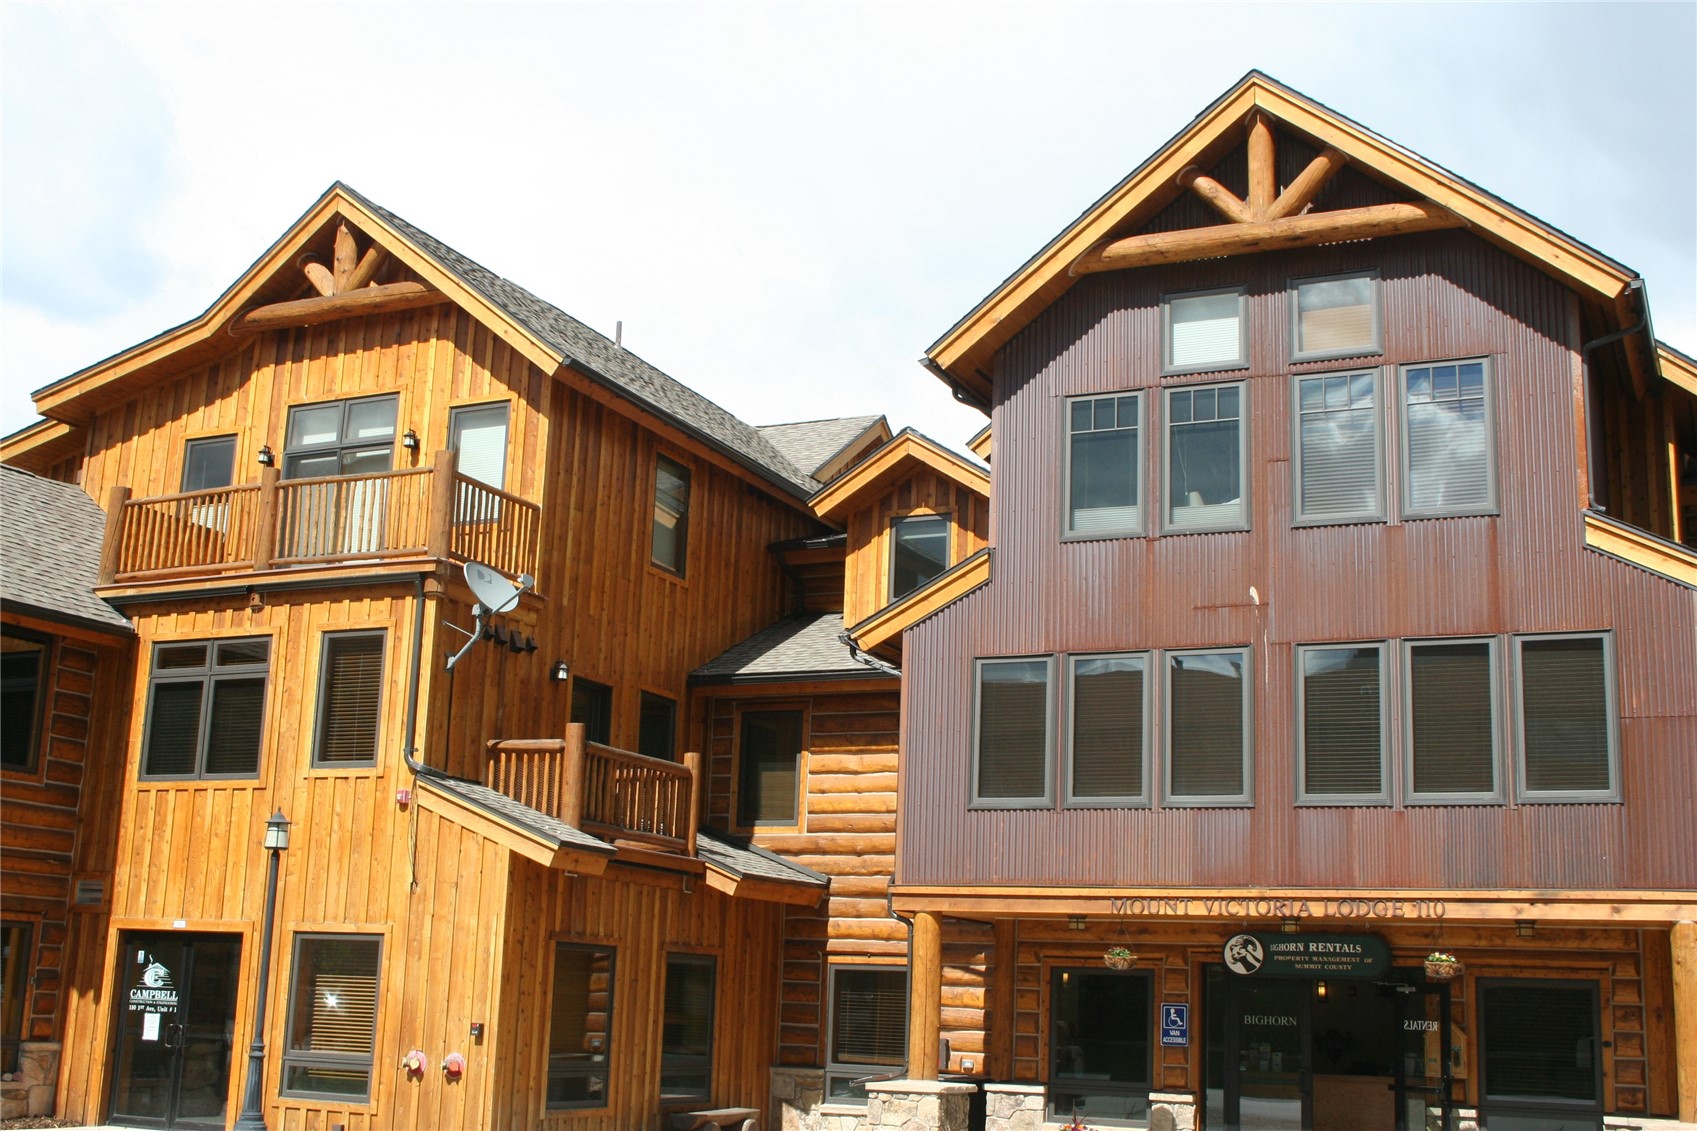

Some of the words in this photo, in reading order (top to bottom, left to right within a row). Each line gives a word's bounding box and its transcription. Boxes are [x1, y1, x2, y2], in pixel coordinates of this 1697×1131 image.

[1110, 897, 1193, 915] MOUNT
[1202, 898, 1313, 917] VICTORIA
[1323, 899, 1406, 918] LODGE
[1415, 900, 1446, 918] 110
[1309, 942, 1362, 953] RENTALS
[130, 988, 178, 1000] CAMPBELL
[1243, 1015, 1297, 1026] BIGHORN
